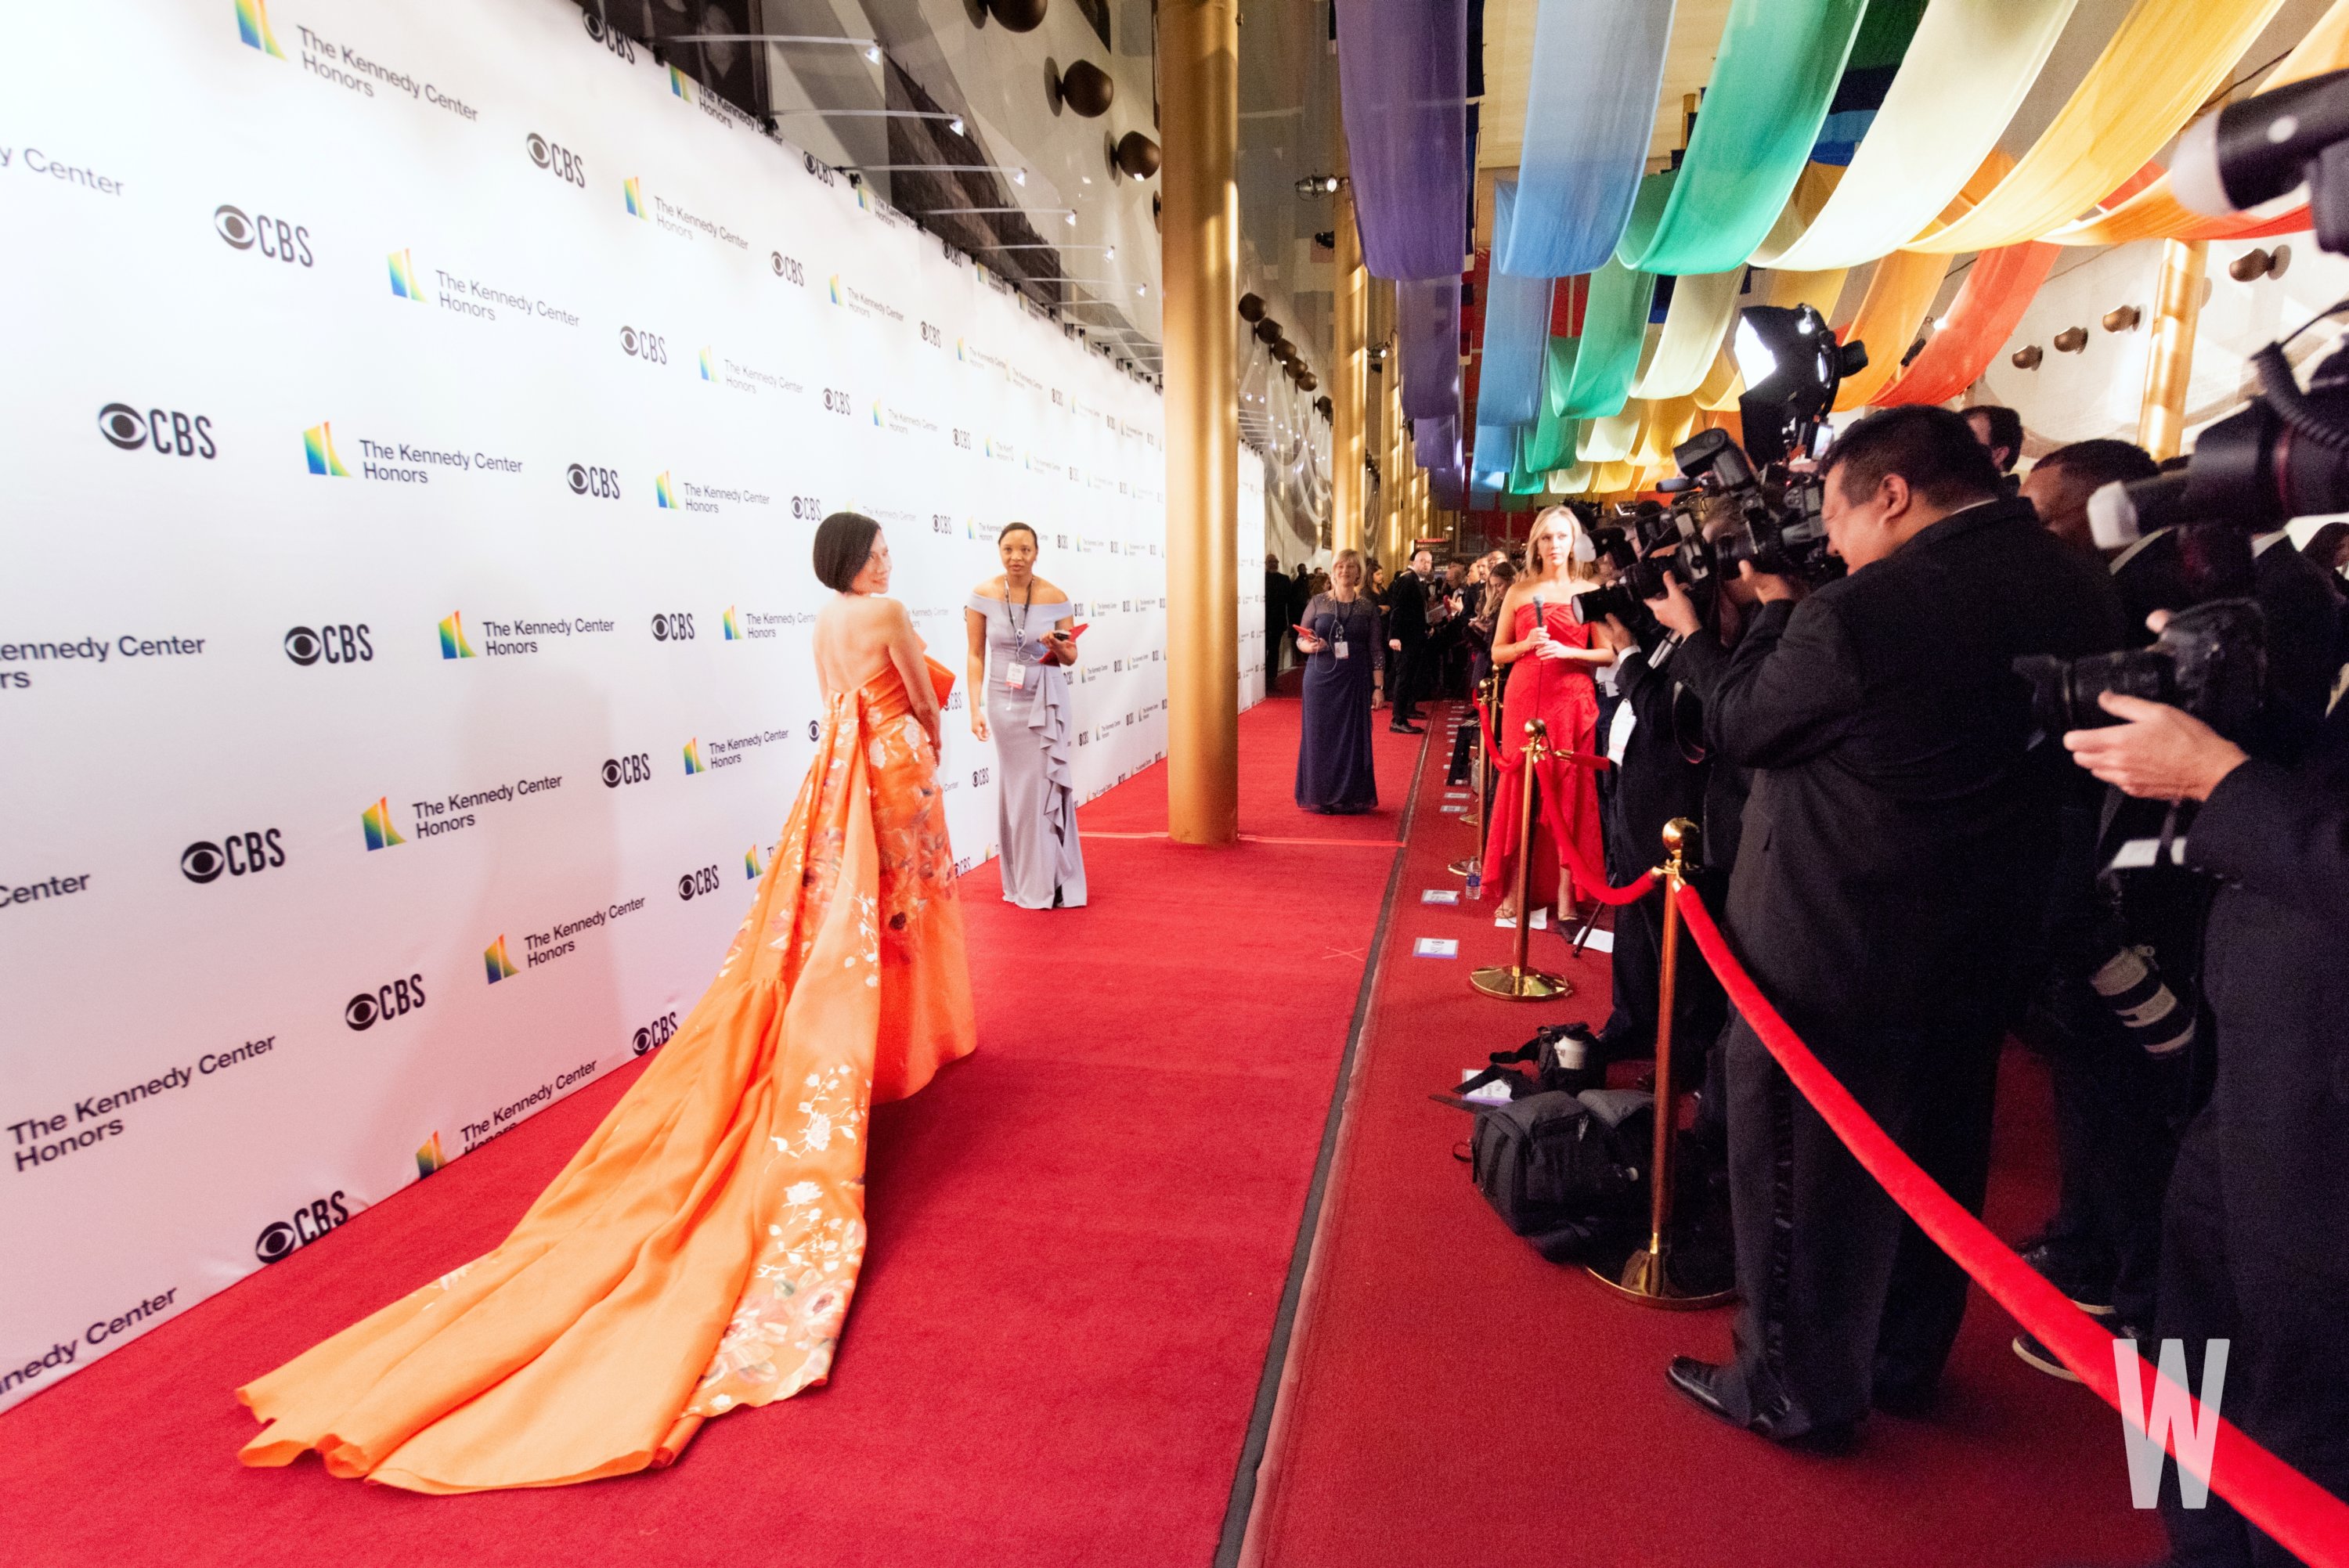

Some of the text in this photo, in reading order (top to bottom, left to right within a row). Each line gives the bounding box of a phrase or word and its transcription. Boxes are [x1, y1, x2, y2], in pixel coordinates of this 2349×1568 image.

[606, 25, 634, 64] CBS
[298, 25, 478, 121] The Kennedy Center
[303, 52, 374, 98] Honors
[699, 98, 732, 129] Honors
[24, 148, 124, 196] Center
[551, 143, 585, 188] CBS
[816, 159, 834, 187] CBS
[655, 196, 748, 251] The Kennedy Center
[657, 213, 693, 240] Honors
[258, 214, 313, 267] CBS
[785, 257, 804, 287] CBS
[436, 269, 579, 327] The Kennedy Center
[439, 292, 496, 321] Honors
[848, 287, 904, 322] The Kennedy Center
[849, 302, 870, 318] Honors
[640, 332, 666, 365] CBS
[929, 324, 941, 348] CBS
[725, 359, 803, 394] The Kennedy Center
[726, 375, 756, 394] Honors
[834, 391, 850, 416] CBS
[150, 409, 215, 459] CBS
[889, 409, 938, 431] The Kennedy Center
[960, 430, 971, 450] CBS
[359, 439, 522, 473] The Kennedy Center
[364, 462, 428, 484] Honors
[590, 466, 620, 499] CBS
[684, 483, 770, 505] The Kennedy Center
[686, 499, 718, 513] Honors
[804, 499, 821, 521] CBS
[940, 515, 951, 535] CBS
[482, 618, 615, 638] The Kennedy Center
[669, 613, 695, 640] CBS
[746, 612, 817, 625] The Kennedy Cente
[748, 627, 776, 639] Honors
[0, 635, 205, 662] ennedy Center
[323, 625, 373, 664] CBS
[486, 639, 538, 656] Honors
[951, 692, 962, 709] CBS
[709, 728, 788, 755] The Kennedy Center
[622, 753, 651, 784] CBS
[711, 752, 741, 770] Honors
[979, 768, 989, 785] CBS
[413, 775, 562, 820] The Kennedy Center
[415, 814, 475, 839] Honors
[225, 828, 285, 875] CBS
[696, 865, 719, 896] CBS
[525, 897, 644, 950] The Kennedy Center
[527, 940, 575, 968] Honors
[379, 973, 426, 1022] CBS
[6, 1036, 276, 1145] The Kennedy Center
[461, 1061, 597, 1142] The Kennedy Center
[14, 1119, 124, 1172] Honors
[294, 1190, 348, 1246] CBS
[0, 1288, 177, 1395] nedy Center
